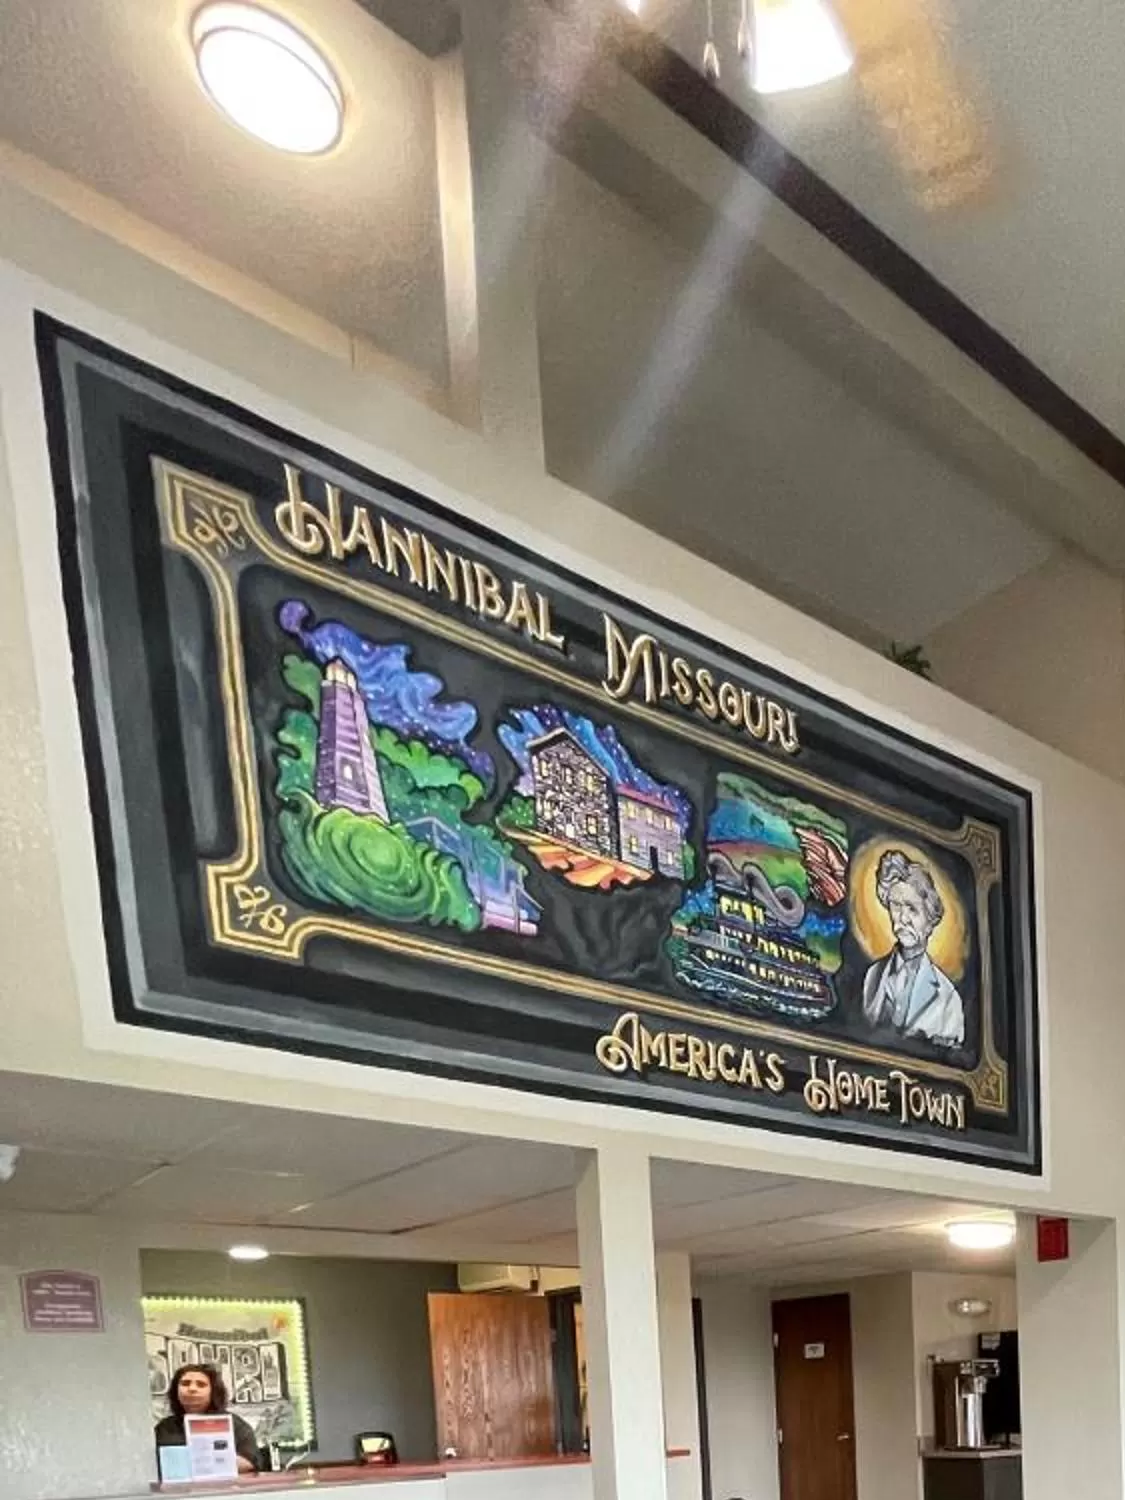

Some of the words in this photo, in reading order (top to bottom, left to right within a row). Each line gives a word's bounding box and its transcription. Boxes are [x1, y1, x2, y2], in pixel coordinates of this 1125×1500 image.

[274, 463, 565, 650] HANNIBAL
[601, 611, 799, 753] MISSOURI
[596, 1012, 786, 1093] AMERICA'S
[803, 1055, 891, 1113] HOME
[889, 1070, 965, 1130] TOWN
